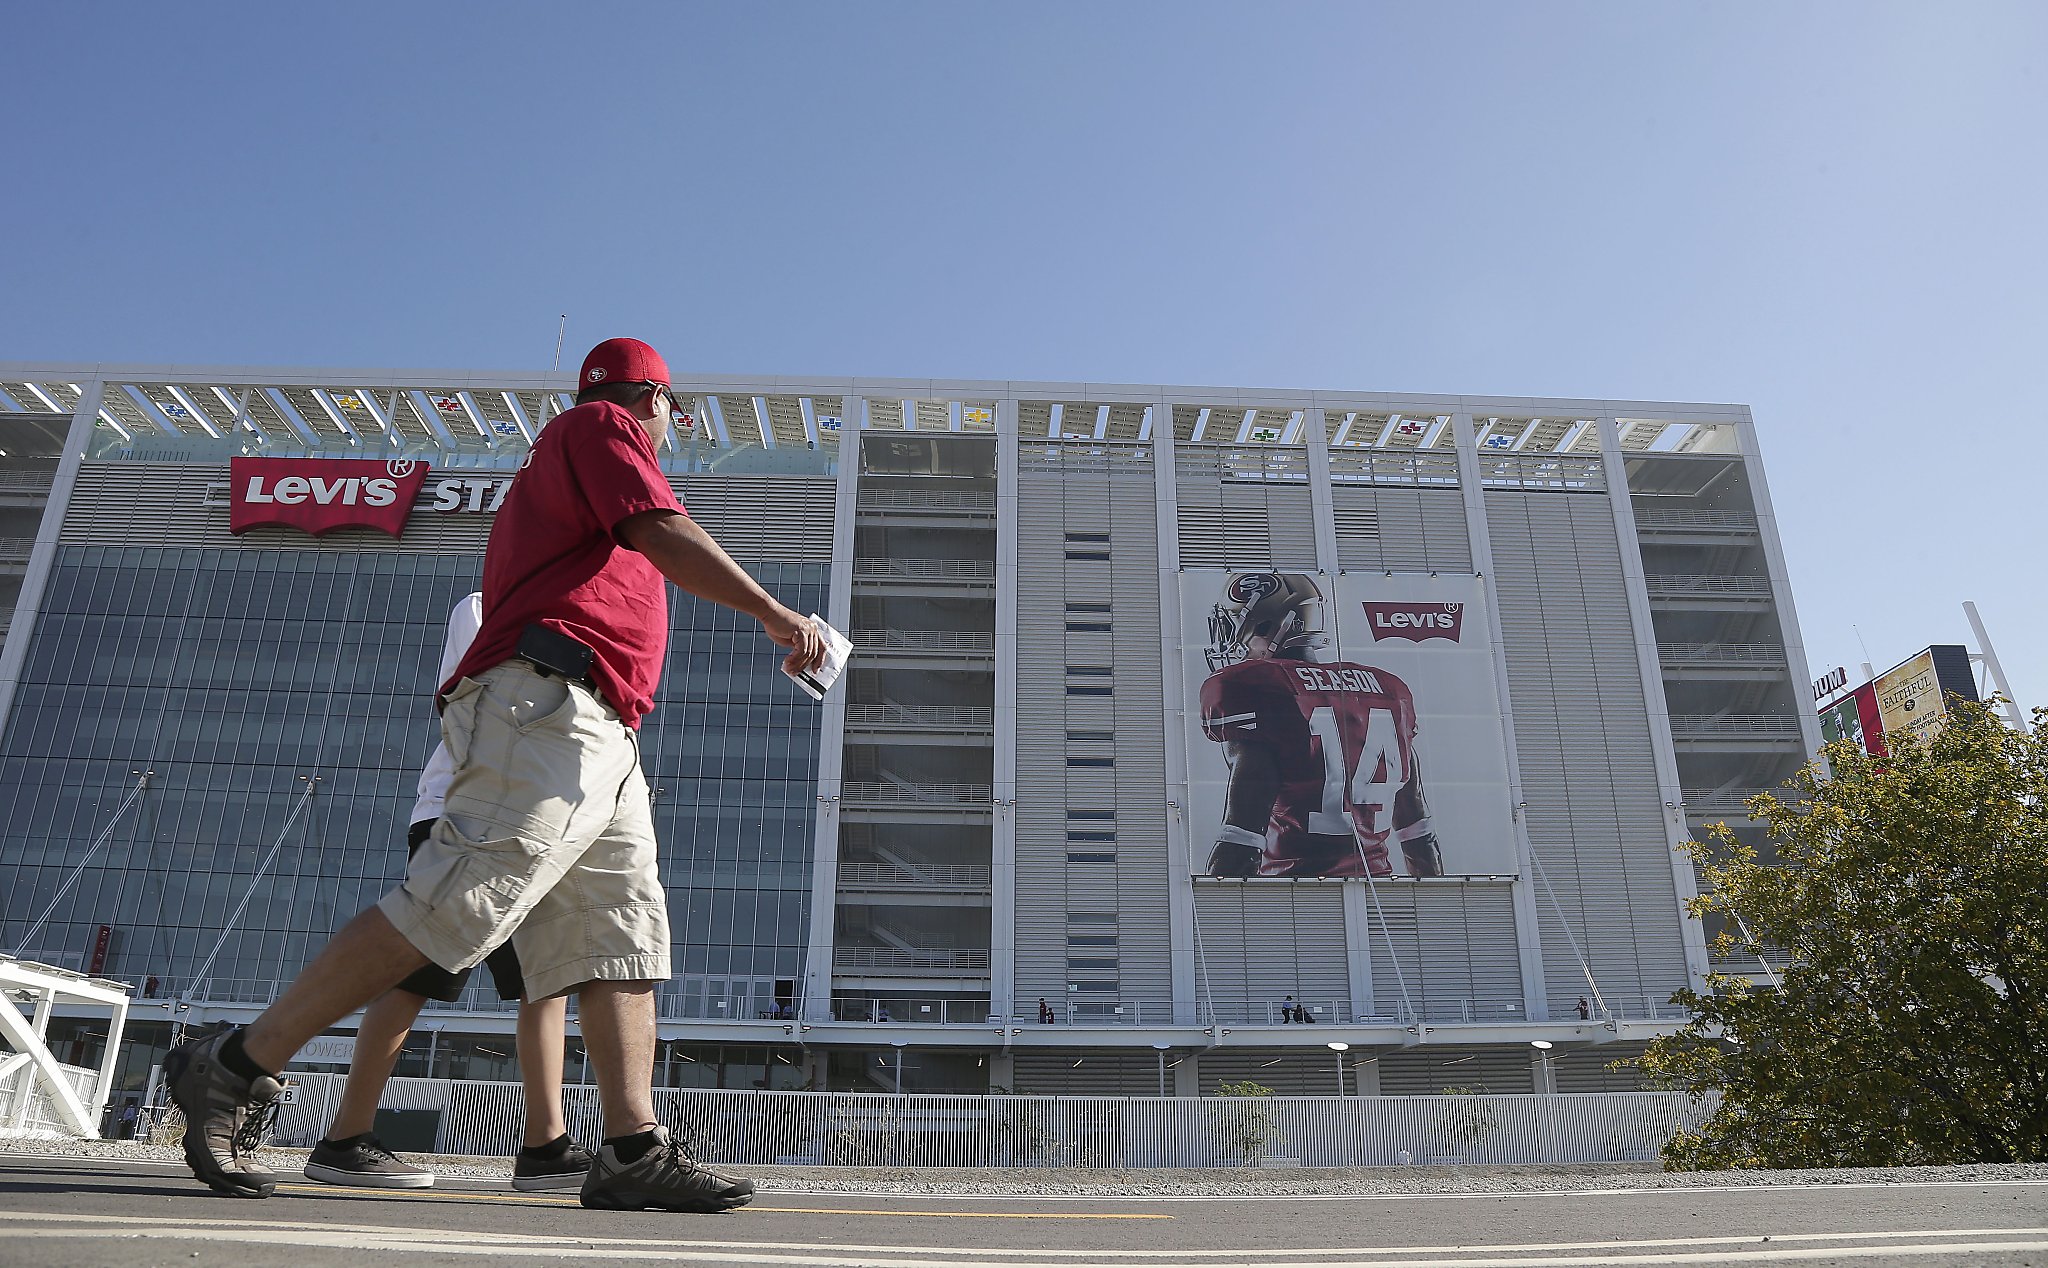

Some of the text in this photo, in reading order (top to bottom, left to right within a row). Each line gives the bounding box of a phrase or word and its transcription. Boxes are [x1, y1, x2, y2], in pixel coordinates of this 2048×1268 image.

[1296, 667, 1384, 694] SEASON
[1883, 676, 1932, 709] FAITHFUL
[1308, 706, 1402, 836] 14
[299, 1041, 353, 1058] OWER
